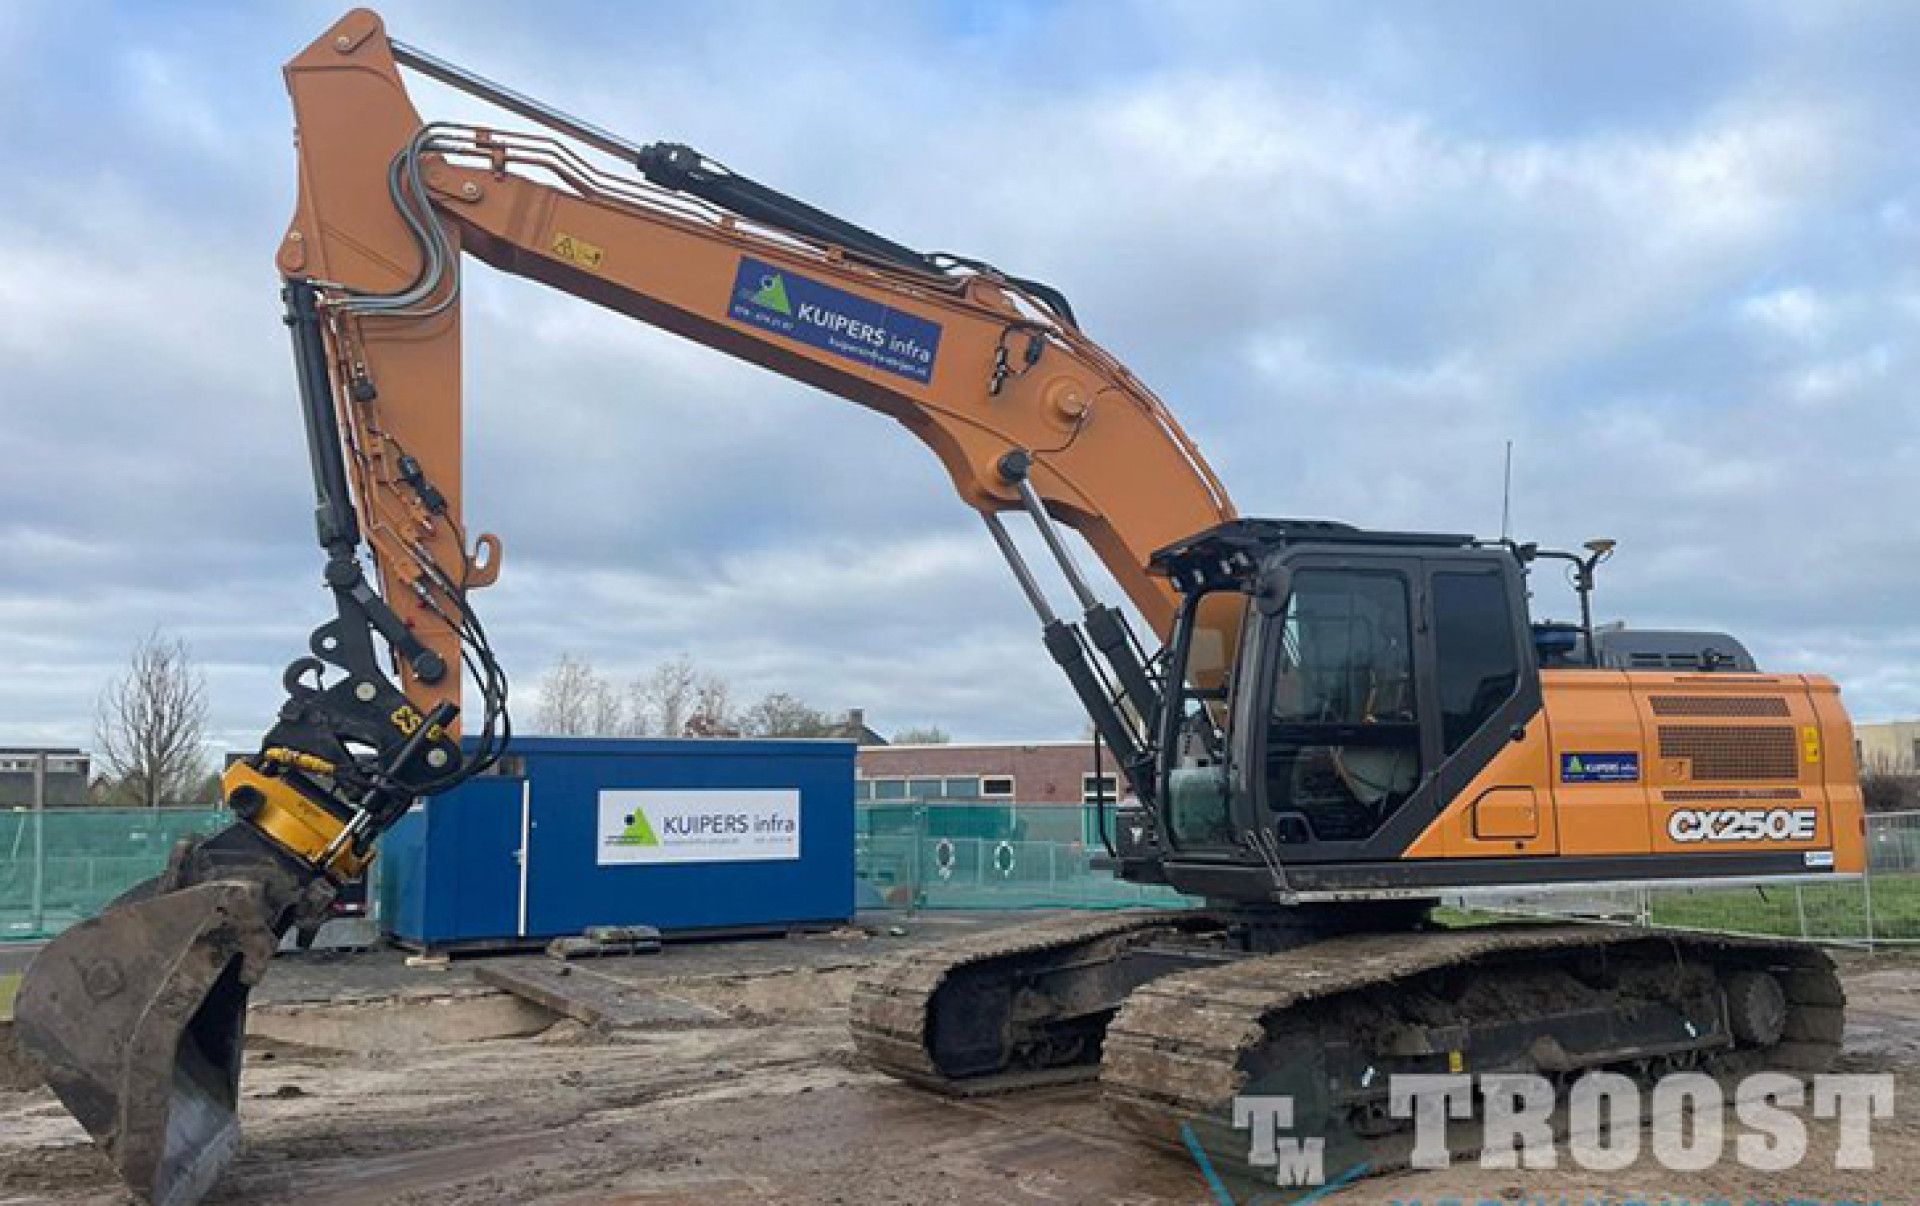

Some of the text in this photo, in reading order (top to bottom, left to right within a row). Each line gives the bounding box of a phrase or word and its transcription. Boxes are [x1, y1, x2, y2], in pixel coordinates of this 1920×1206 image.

[798, 303, 887, 347] KUIPERS
[889, 335, 931, 363] infra
[663, 812, 796, 835] KUIPERS infra
[1667, 807, 1817, 842] CX250E
